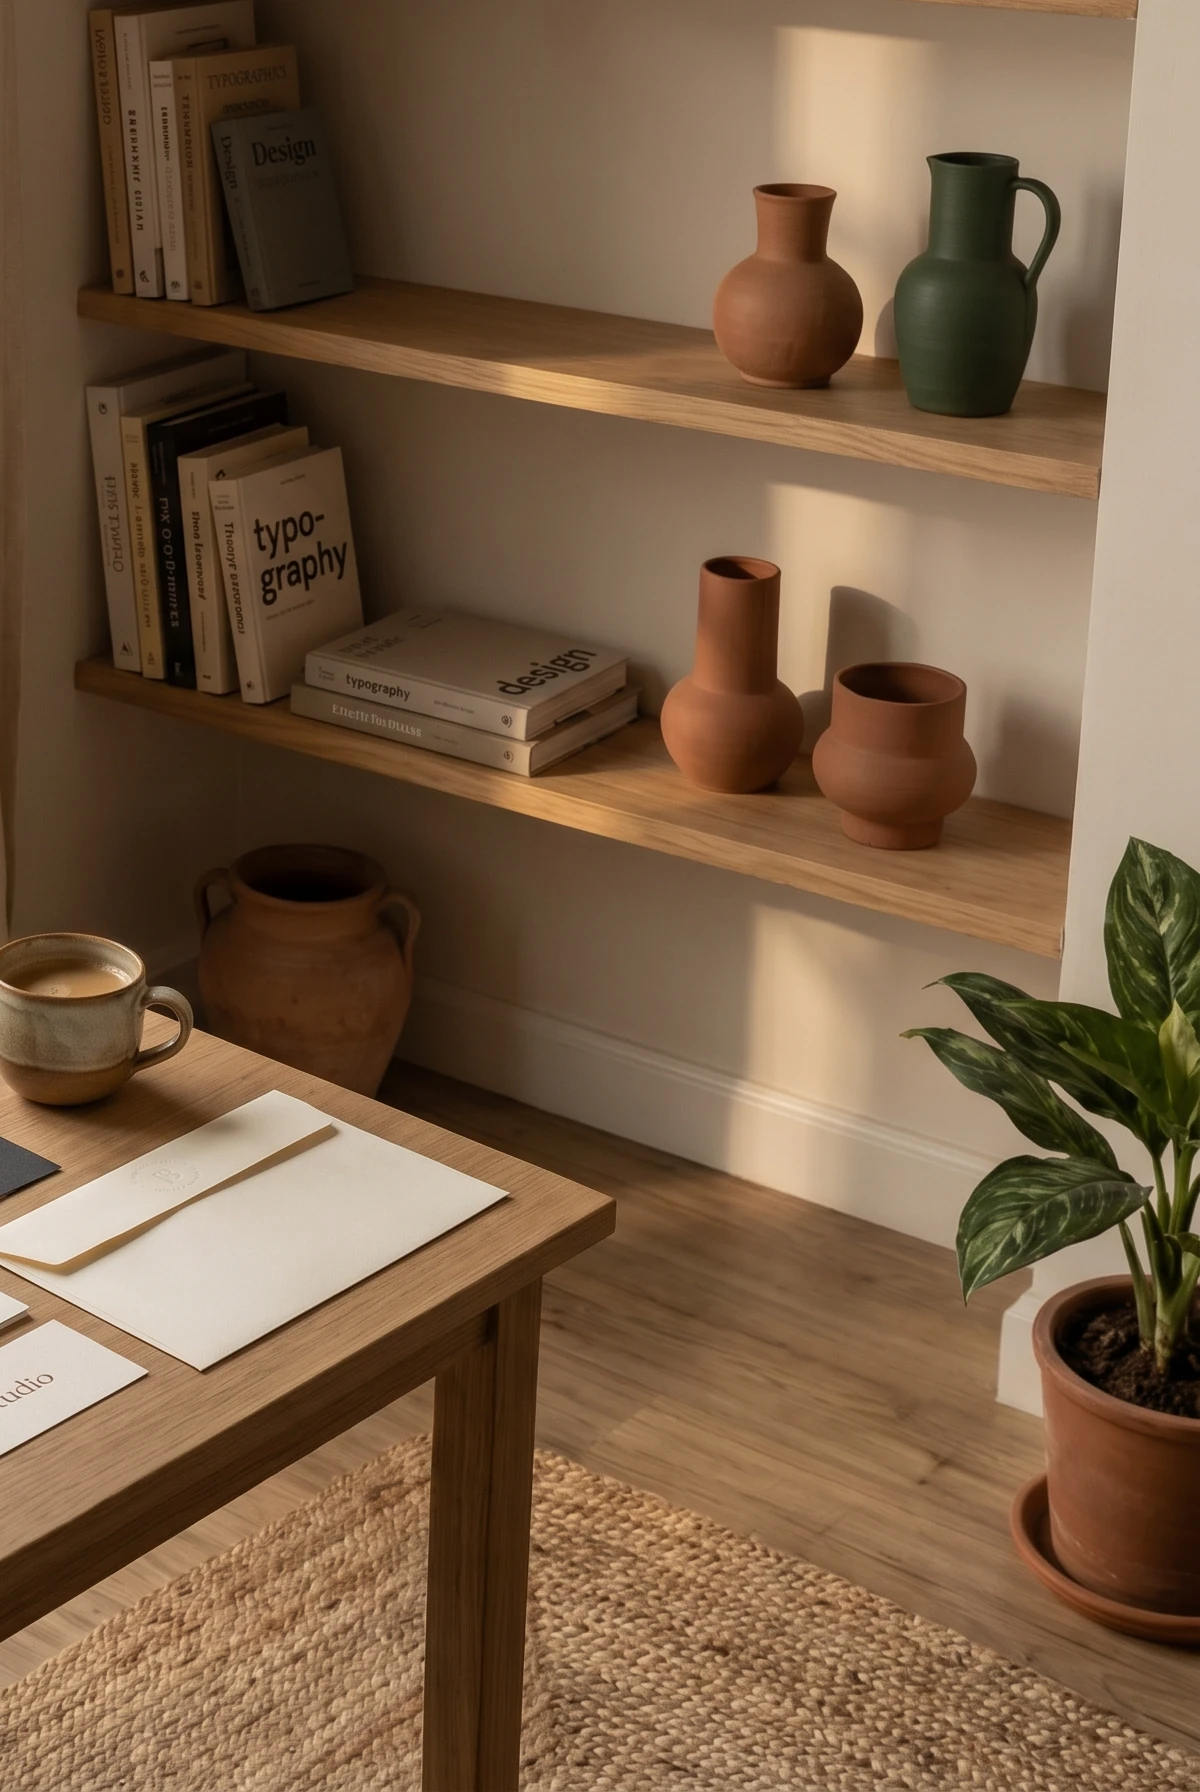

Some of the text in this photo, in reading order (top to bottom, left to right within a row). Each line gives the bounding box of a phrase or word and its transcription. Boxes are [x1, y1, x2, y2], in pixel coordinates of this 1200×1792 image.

[252, 136, 317, 166] Design
[253, 511, 325, 558] typo-
[260, 541, 348, 606] graphy
[346, 674, 411, 702] typography
[497, 649, 597, 695] design
